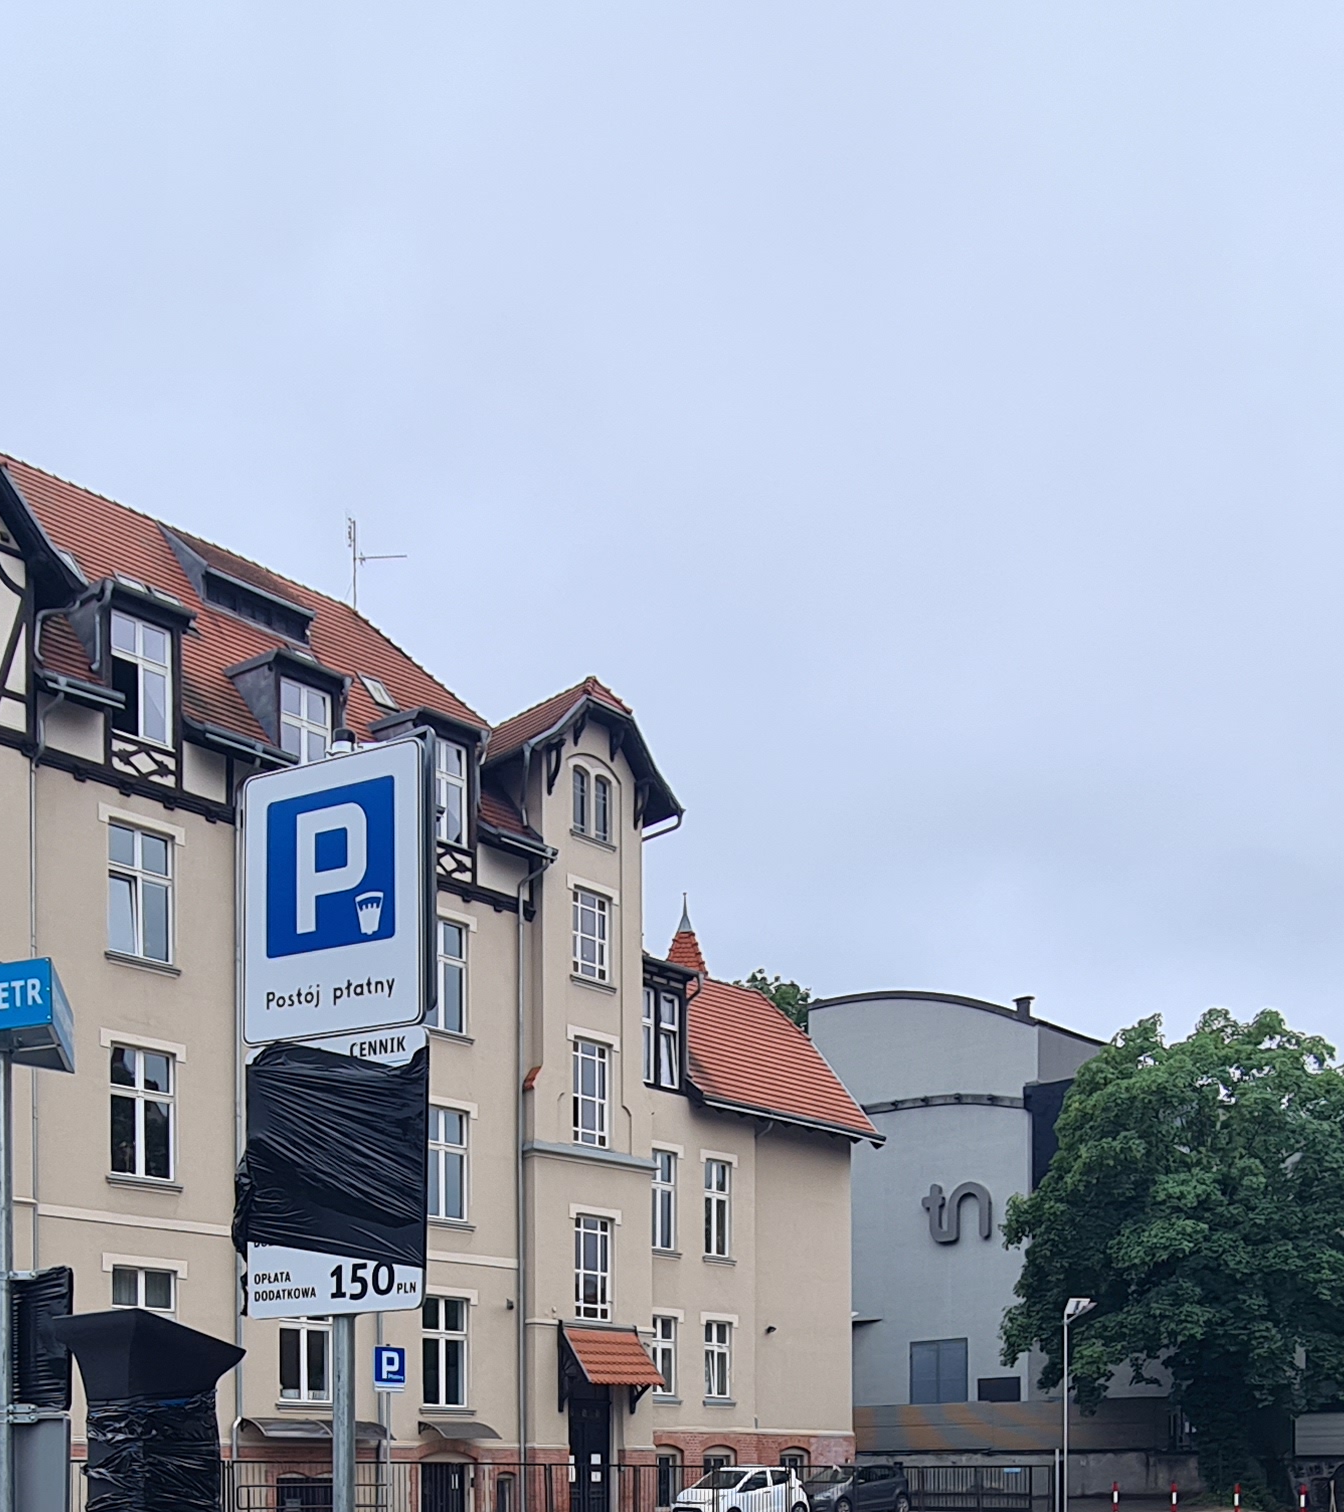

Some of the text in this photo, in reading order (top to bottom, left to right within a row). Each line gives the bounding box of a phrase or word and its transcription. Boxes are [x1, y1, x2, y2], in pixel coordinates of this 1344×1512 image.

[296, 801, 368, 935] P
[266, 976, 395, 1010] Postój płatny
[350, 1035, 407, 1058] CENNIK
[254, 1271, 291, 1285] OPŁATA
[330, 1261, 417, 1301] 150 PLN
[254, 1286, 317, 1302] DODATKOWA
[381, 1350, 400, 1379] P
